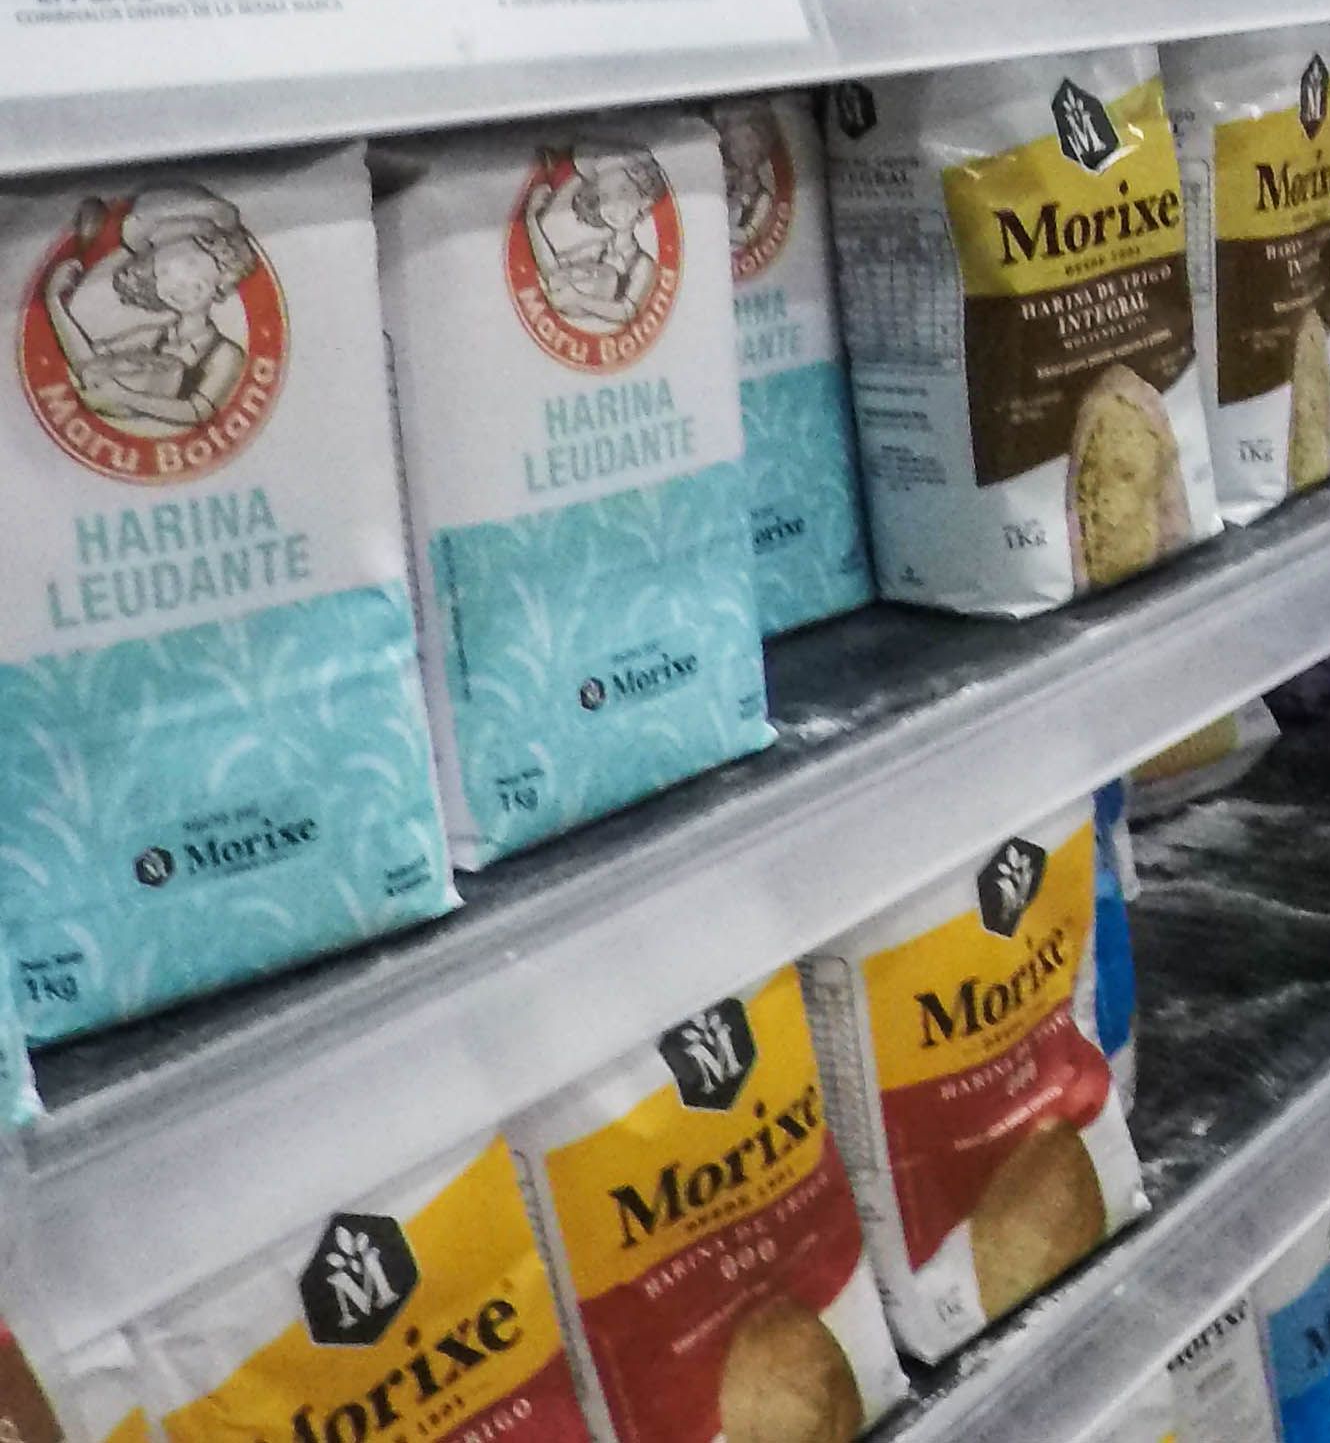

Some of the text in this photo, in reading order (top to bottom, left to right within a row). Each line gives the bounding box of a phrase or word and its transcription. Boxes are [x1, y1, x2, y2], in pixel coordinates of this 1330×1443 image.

[993, 179, 1181, 269] Morixe
[516, 285, 589, 365] Maru
[1021, 262, 1172, 322] HARINA DE TRIGO
[1057, 290, 1149, 335] INTEGRAL
[37, 382, 140, 475] Maru
[543, 376, 676, 442] HARINA
[522, 413, 696, 495] LEUDANTE
[75, 485, 279, 564] HARINA
[46, 532, 311, 631] LEUDANTE
[611, 651, 698, 700] Morixe
[183, 816, 319, 876] Morixe
[644, 1238, 726, 1301] HARINA
